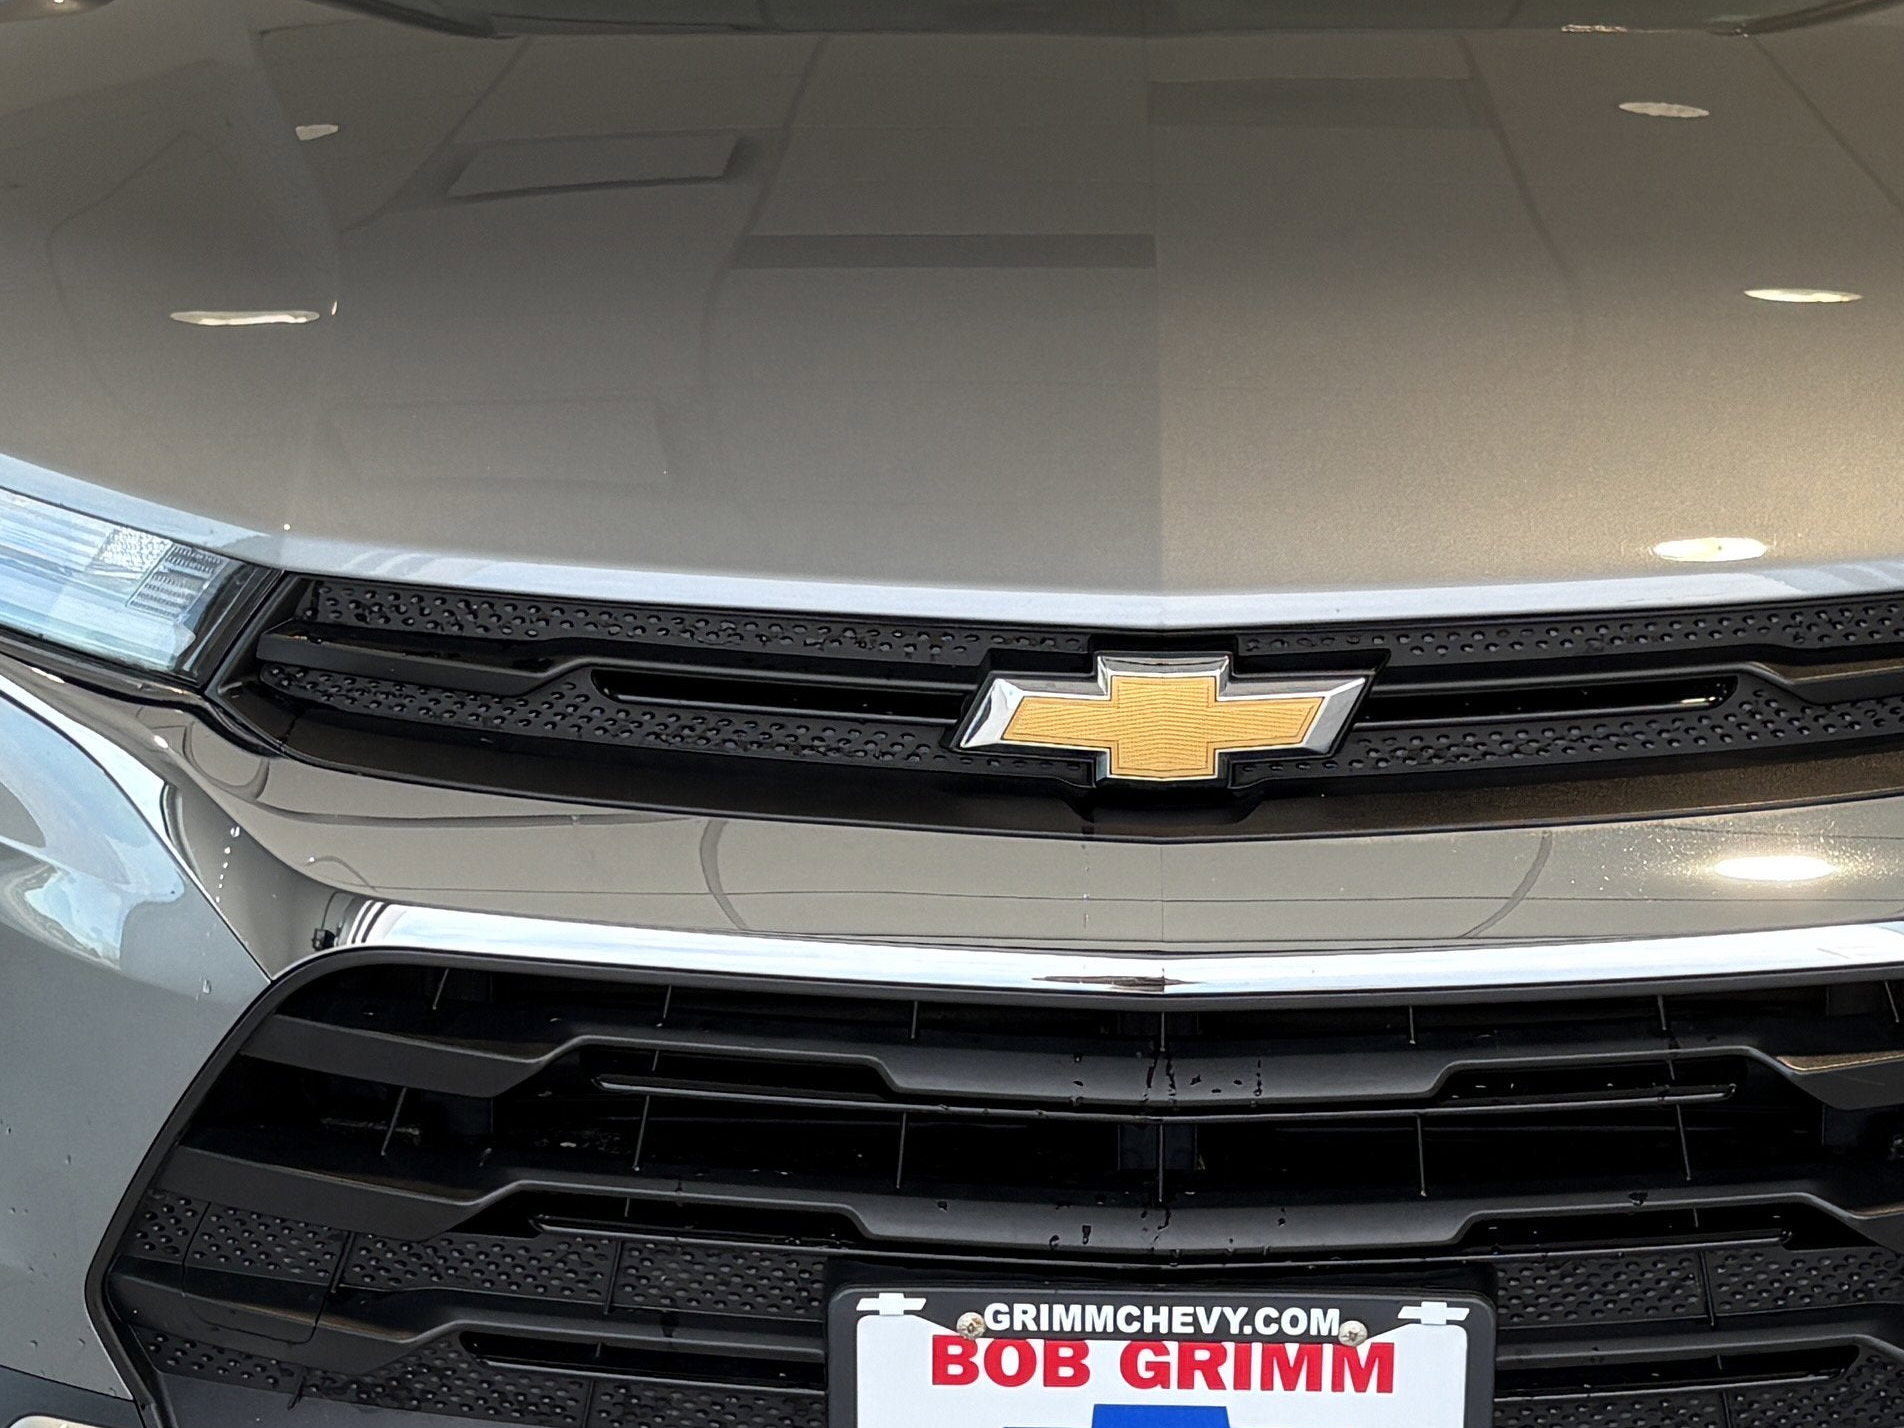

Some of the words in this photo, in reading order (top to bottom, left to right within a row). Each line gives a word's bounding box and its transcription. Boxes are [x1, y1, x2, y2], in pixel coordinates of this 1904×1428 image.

[983, 1303, 1340, 1336] GRIMMCHEVY.COM
[932, 1335, 1091, 1387] BOB
[1120, 1339, 1394, 1394] GRIMM
